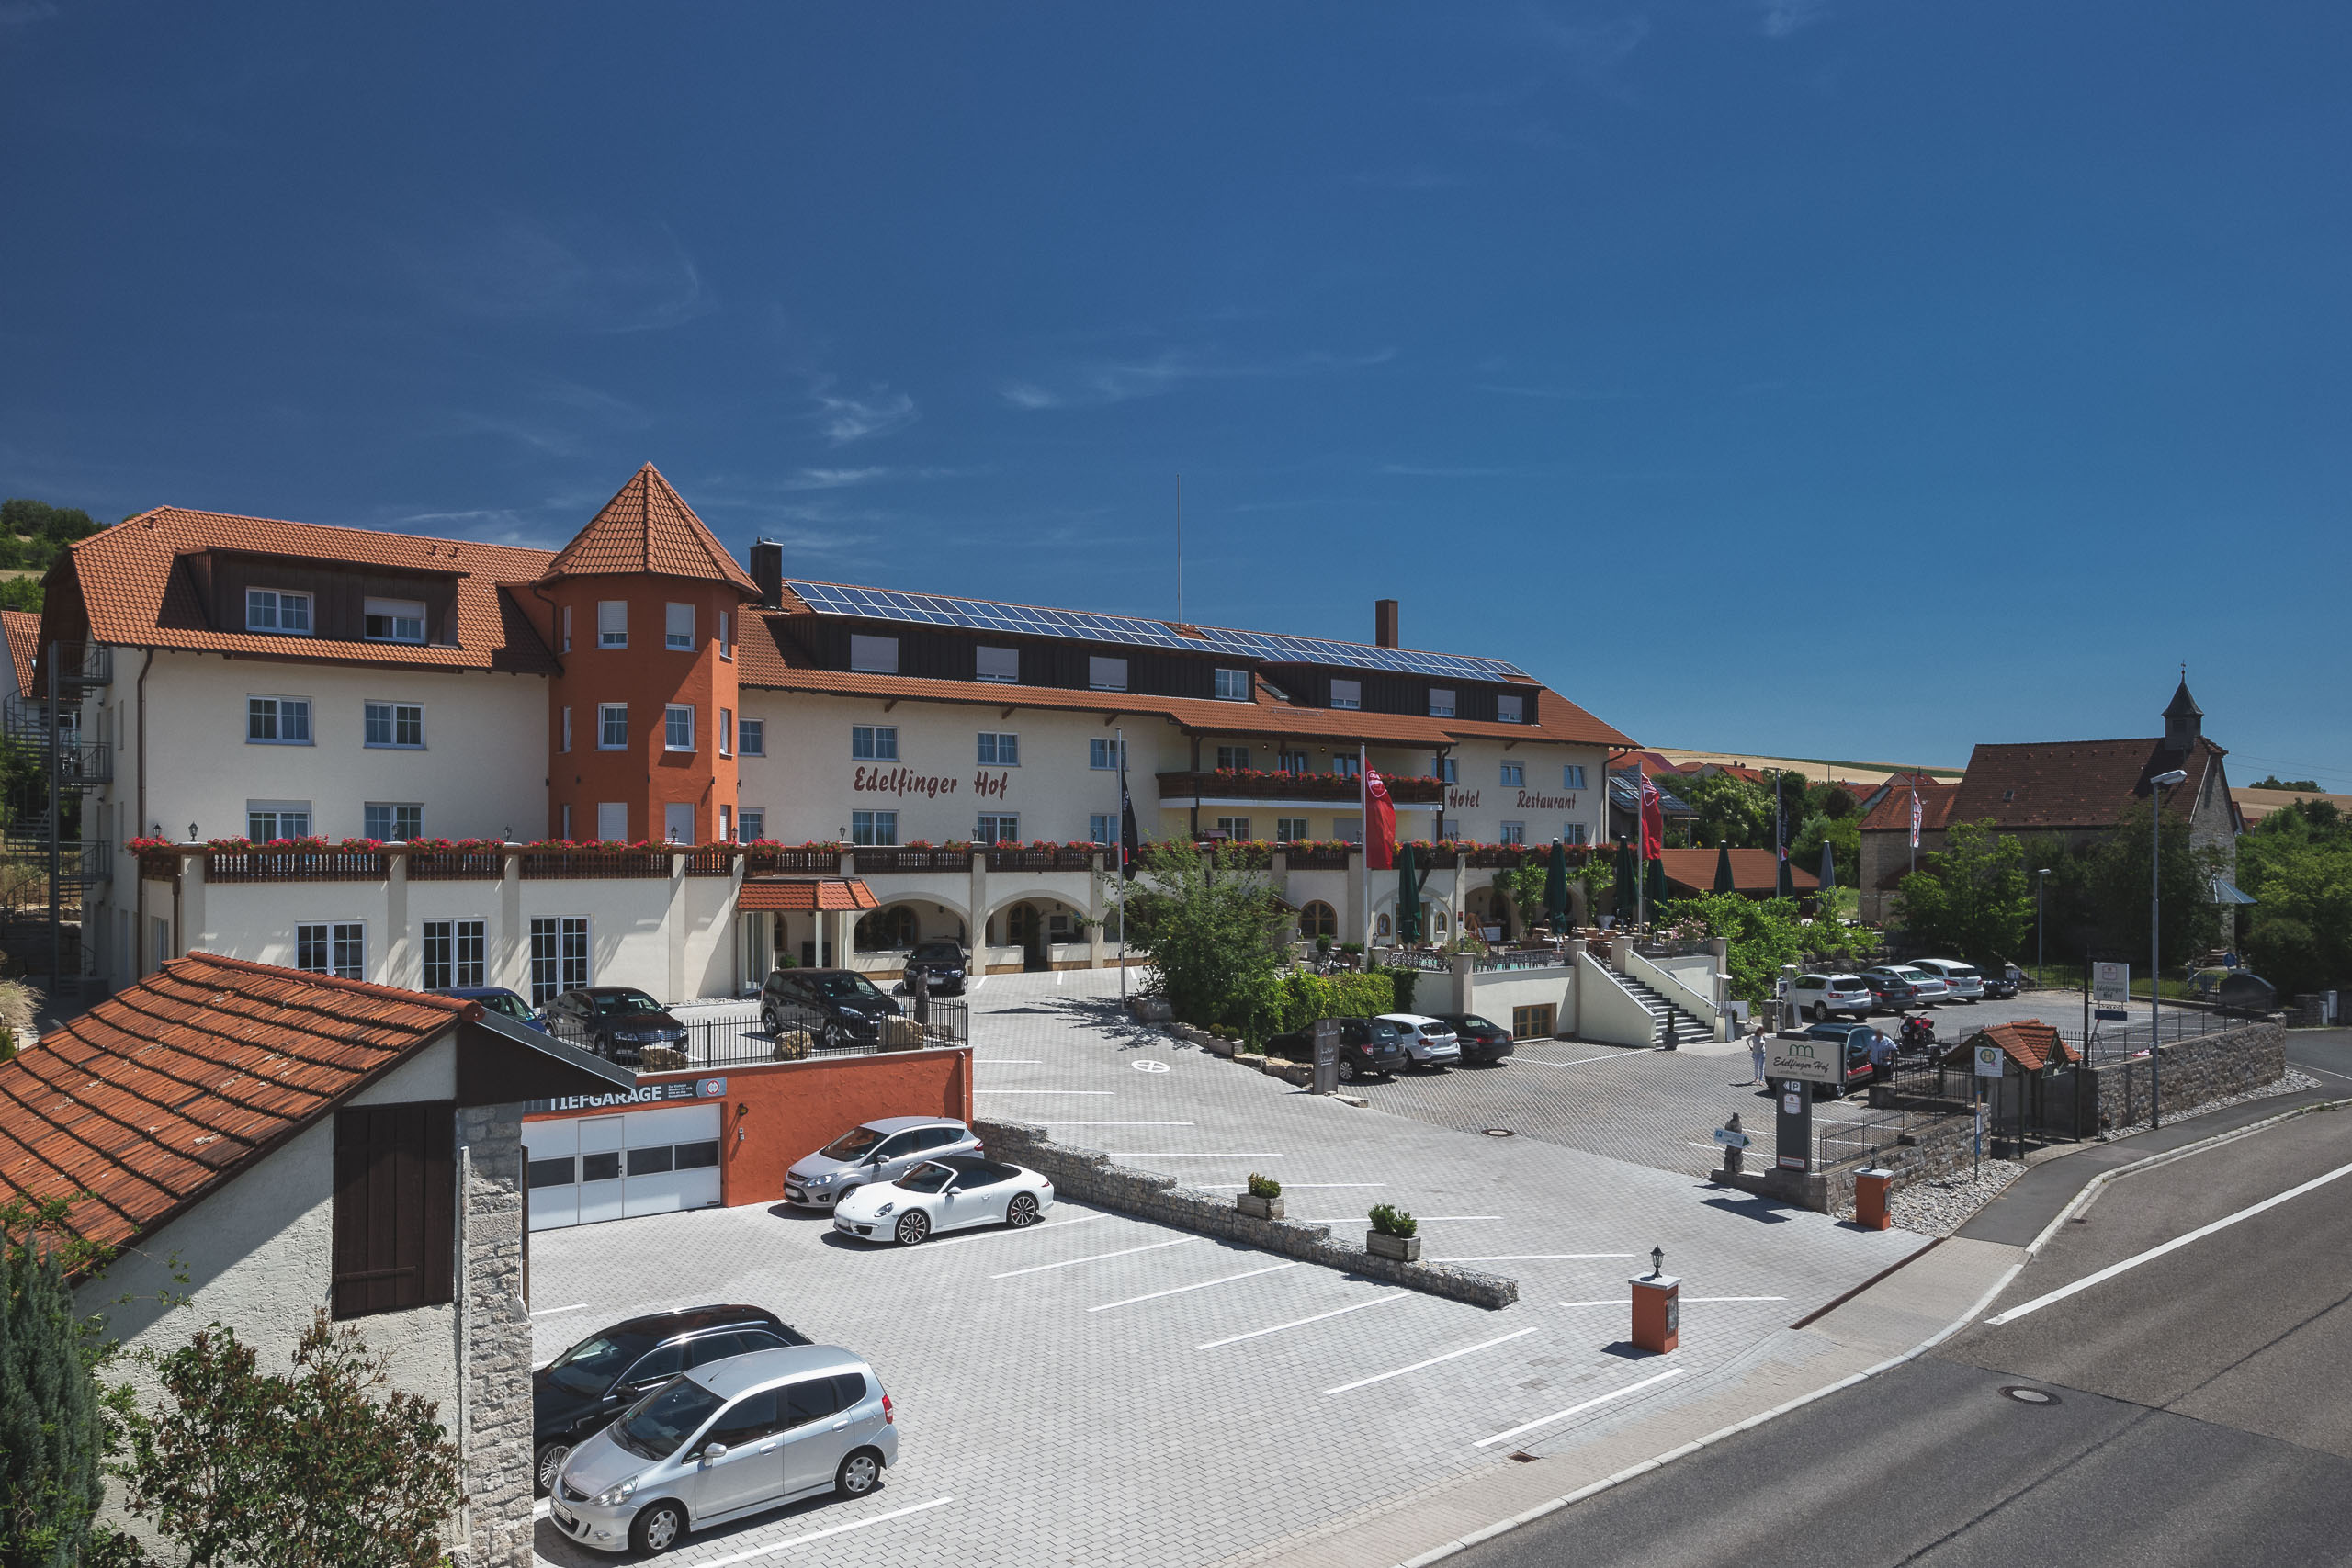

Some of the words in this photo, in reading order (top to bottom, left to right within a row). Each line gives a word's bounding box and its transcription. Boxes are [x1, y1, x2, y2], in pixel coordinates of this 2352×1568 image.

[854, 766, 958, 799] Edelfinger
[974, 771, 1008, 800] Hof
[1449, 788, 1480, 808] Hotel
[1517, 790, 1577, 809] Restaurant
[2096, 984, 2124, 993] Edelfinger
[1984, 1050, 1992, 1060] H
[1773, 1056, 1812, 1070] Edelfinger
[1814, 1061, 1829, 1073] Hof
[1792, 1082, 1799, 1090] P
[550, 1086, 662, 1111] TIEFGARAGE
